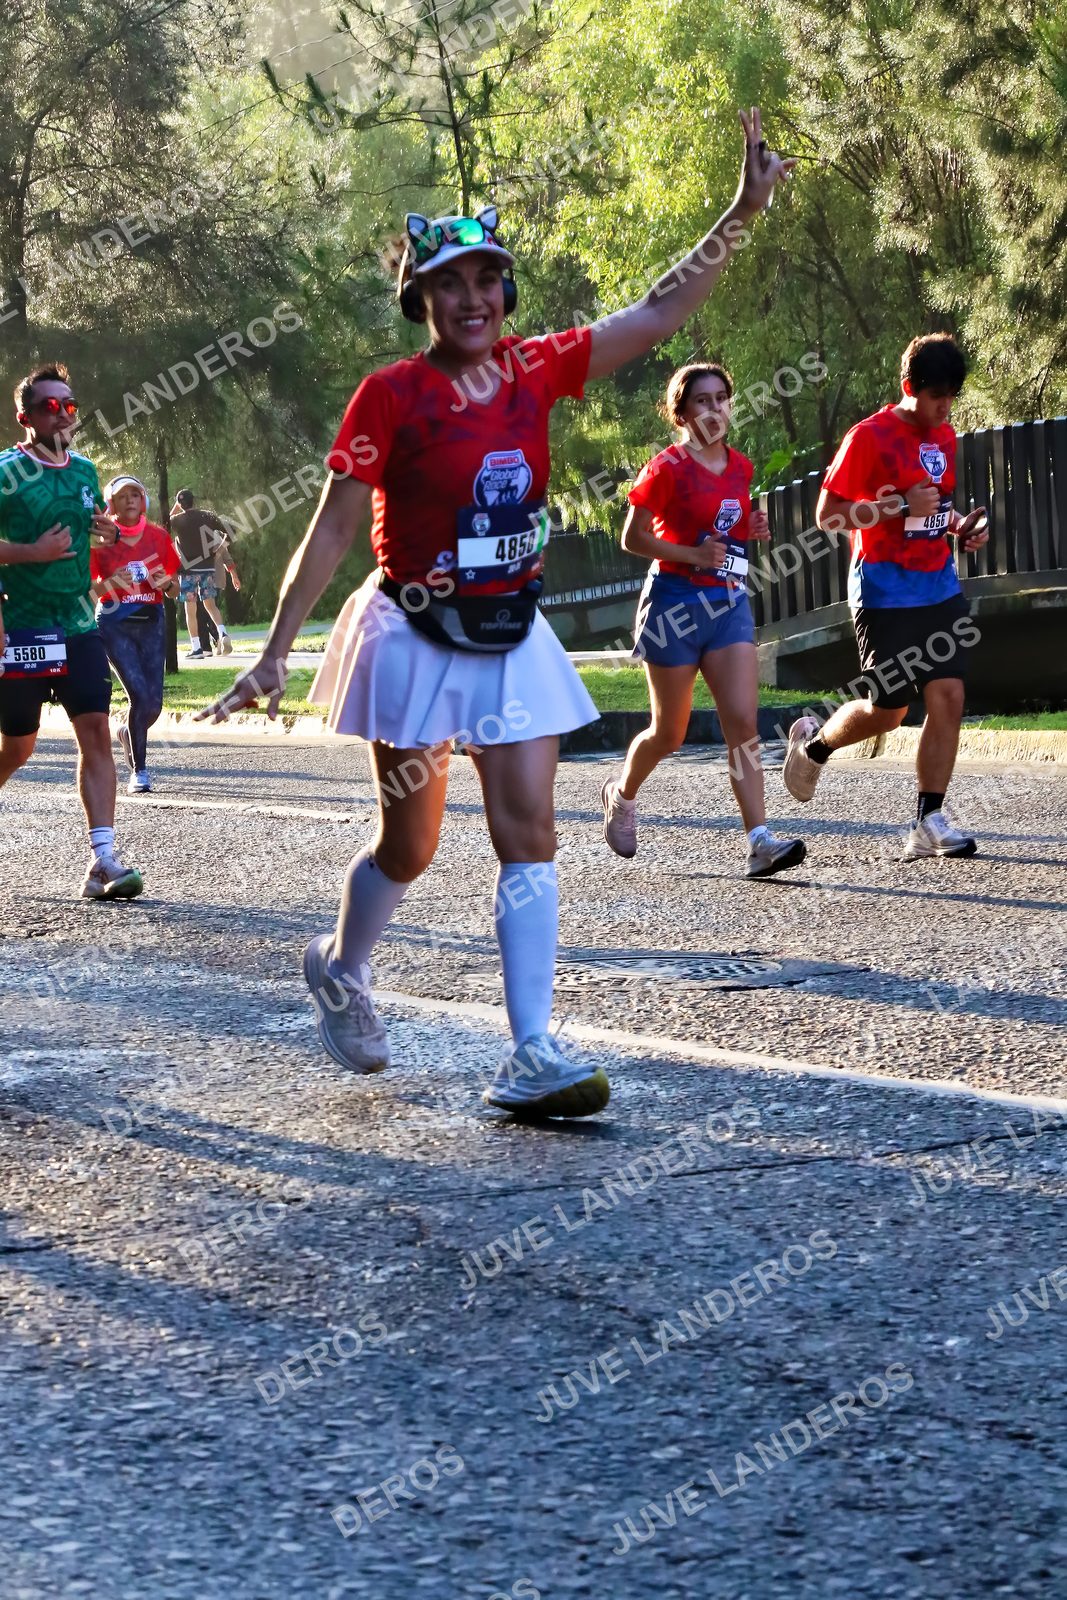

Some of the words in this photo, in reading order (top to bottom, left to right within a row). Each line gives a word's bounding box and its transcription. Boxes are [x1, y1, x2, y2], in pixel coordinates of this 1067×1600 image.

[488, 457, 519, 467] BIMBO
[490, 470, 520, 481] Global
[484, 480, 508, 491] Race
[924, 514, 946, 529] 4856
[495, 531, 536, 561] 4850
[13, 647, 46, 662] 5580
